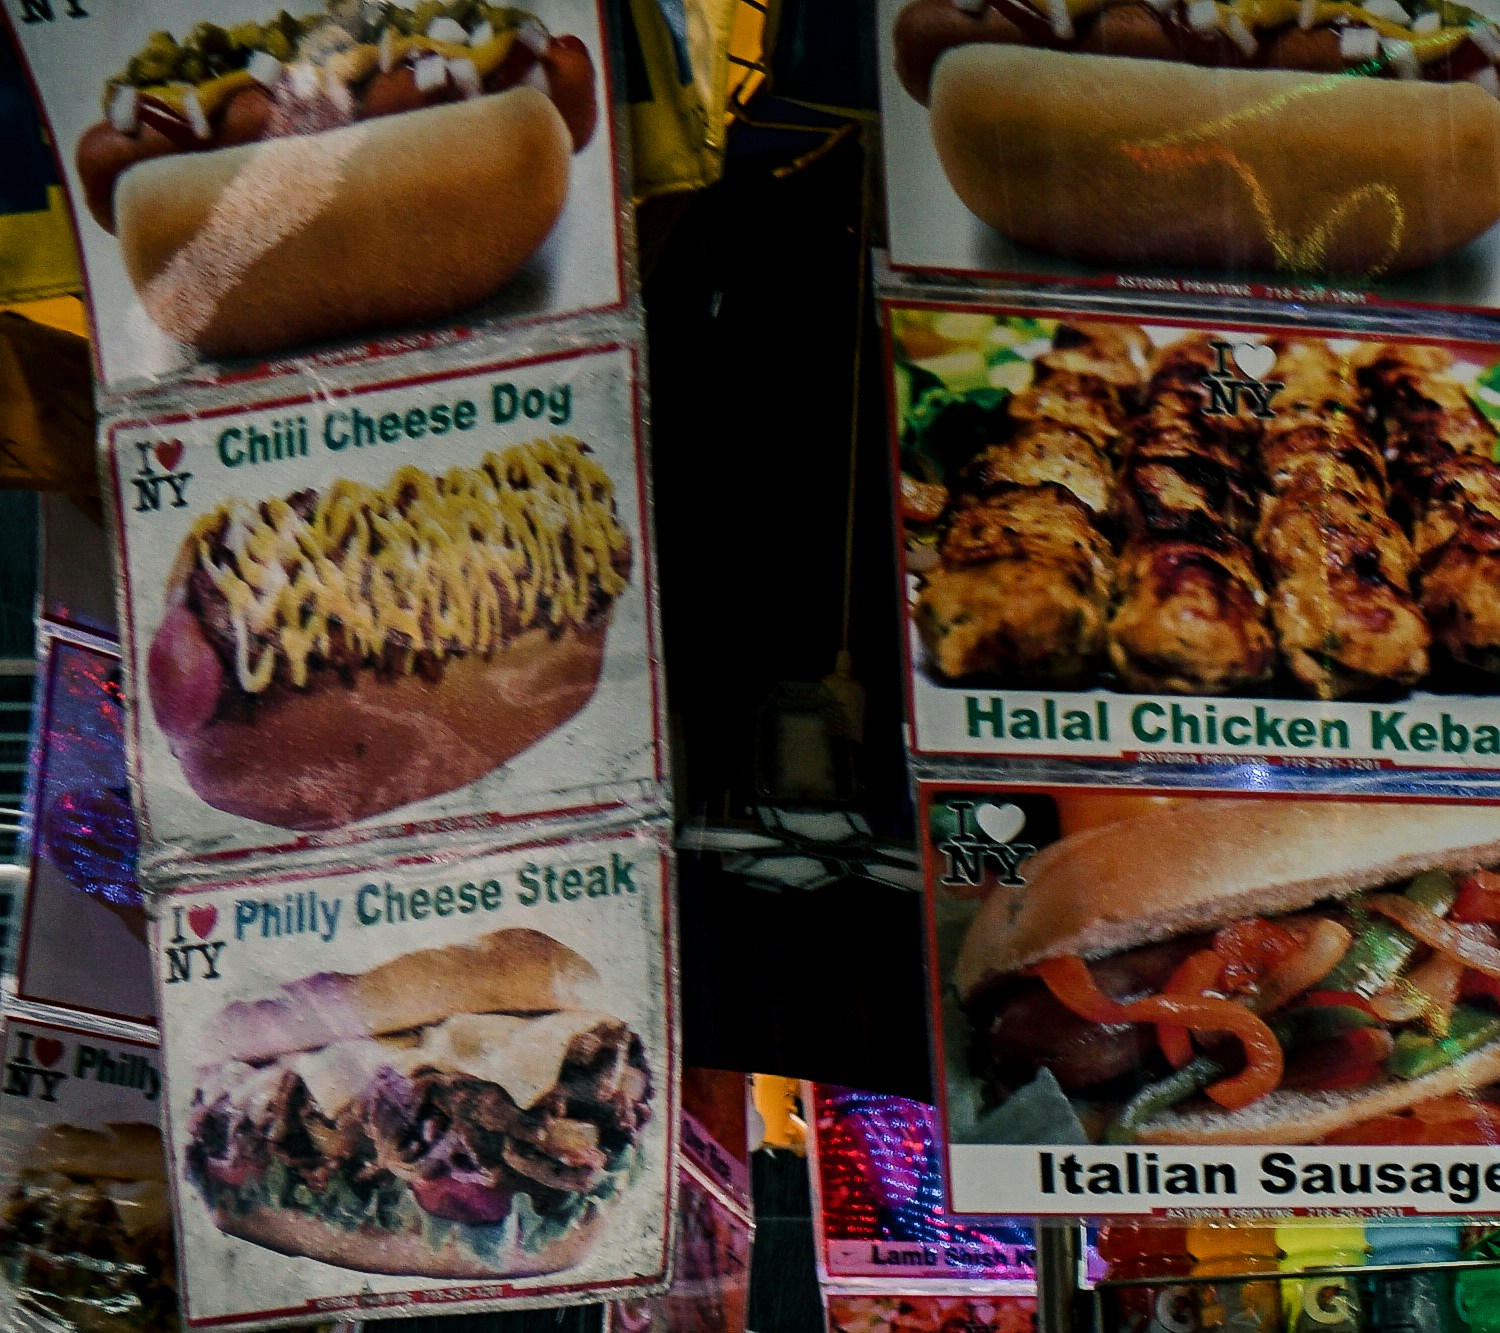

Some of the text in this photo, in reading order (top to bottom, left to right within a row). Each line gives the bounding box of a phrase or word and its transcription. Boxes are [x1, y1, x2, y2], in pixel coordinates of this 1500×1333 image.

[1211, 341, 1230, 377] I
[1202, 380, 1285, 419] NY
[217, 380, 574, 471] Chili Cheese Dog
[135, 440, 154, 474] I
[133, 473, 193, 515] NY
[966, 697, 1110, 742] Halal
[1130, 703, 1350, 751] Chicken
[954, 801, 974, 841] I
[941, 843, 1035, 889] NY
[233, 853, 639, 944] Philly Cheese Steak
[171, 906, 189, 942] I
[165, 942, 226, 985] NY
[4, 1062, 68, 1104] NY
[1039, 1151, 1236, 1197] Italian
[873, 1244, 937, 1266] Lamb
